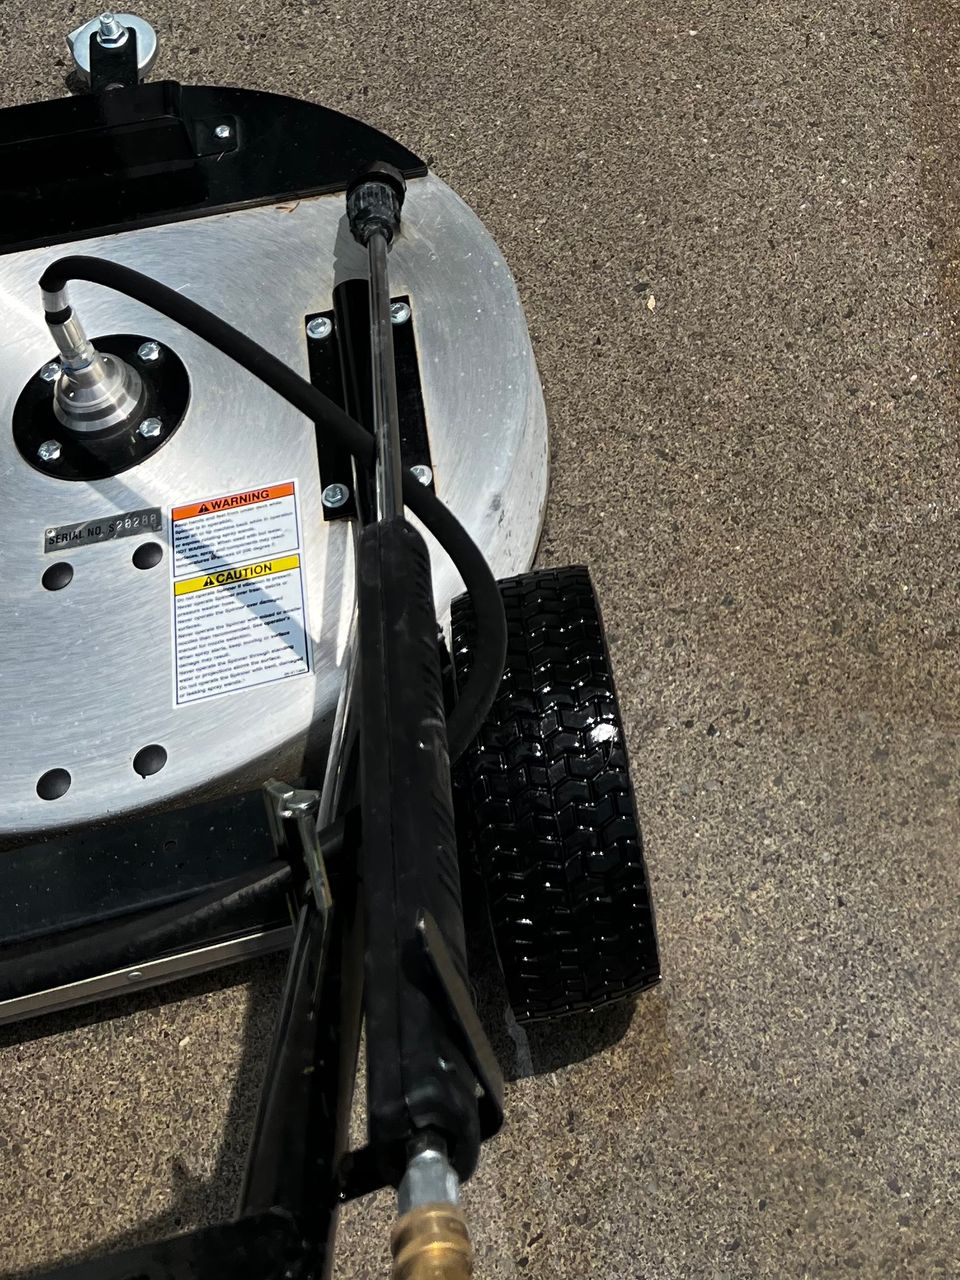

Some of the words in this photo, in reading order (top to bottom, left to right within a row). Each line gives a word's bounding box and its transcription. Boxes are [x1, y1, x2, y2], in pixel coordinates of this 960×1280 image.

[211, 490, 269, 510] WARNING
[48, 531, 82, 545] SERIAL
[216, 563, 272, 584] CAUTION
